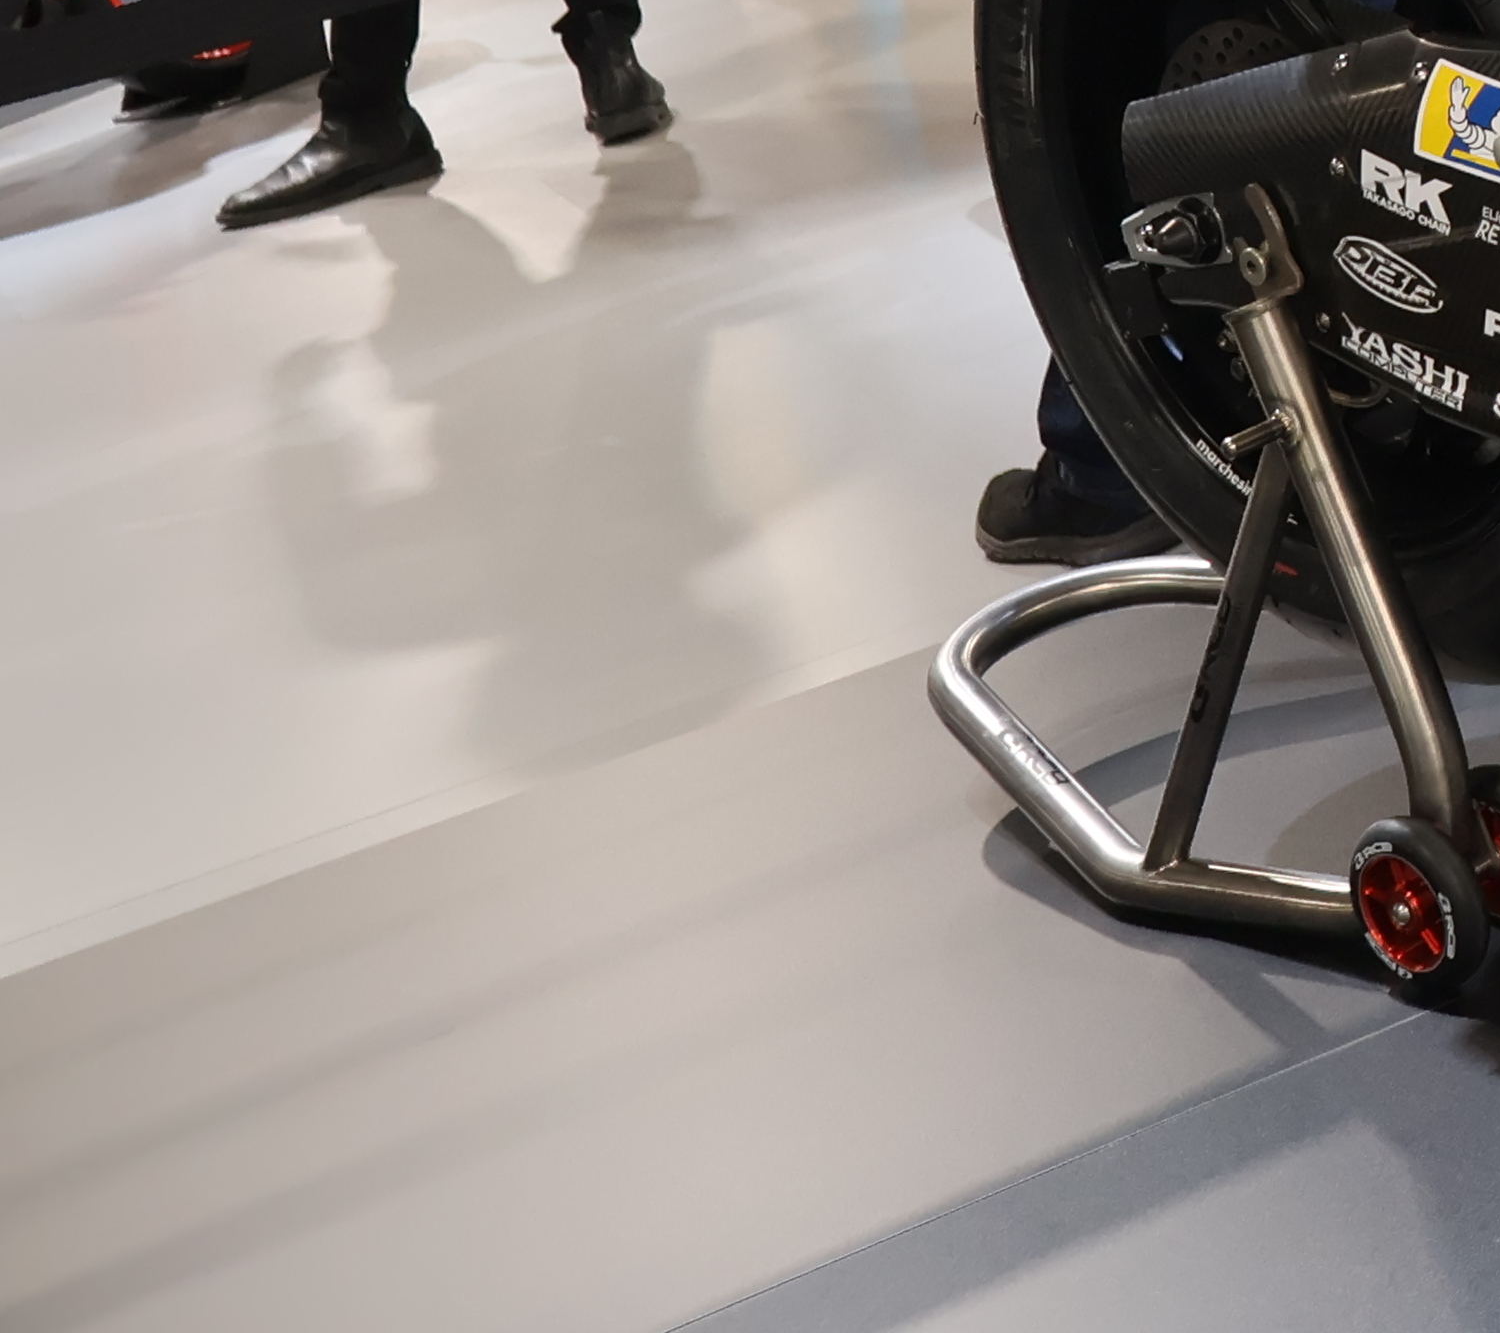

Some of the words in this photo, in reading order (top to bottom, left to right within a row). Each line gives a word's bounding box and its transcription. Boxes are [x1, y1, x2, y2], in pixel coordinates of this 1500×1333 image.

[1361, 148, 1453, 225] RK
[1361, 188, 1416, 220] TAKASAGO
[1417, 214, 1453, 237] CHAIN
[1342, 311, 1470, 399] YASHI
